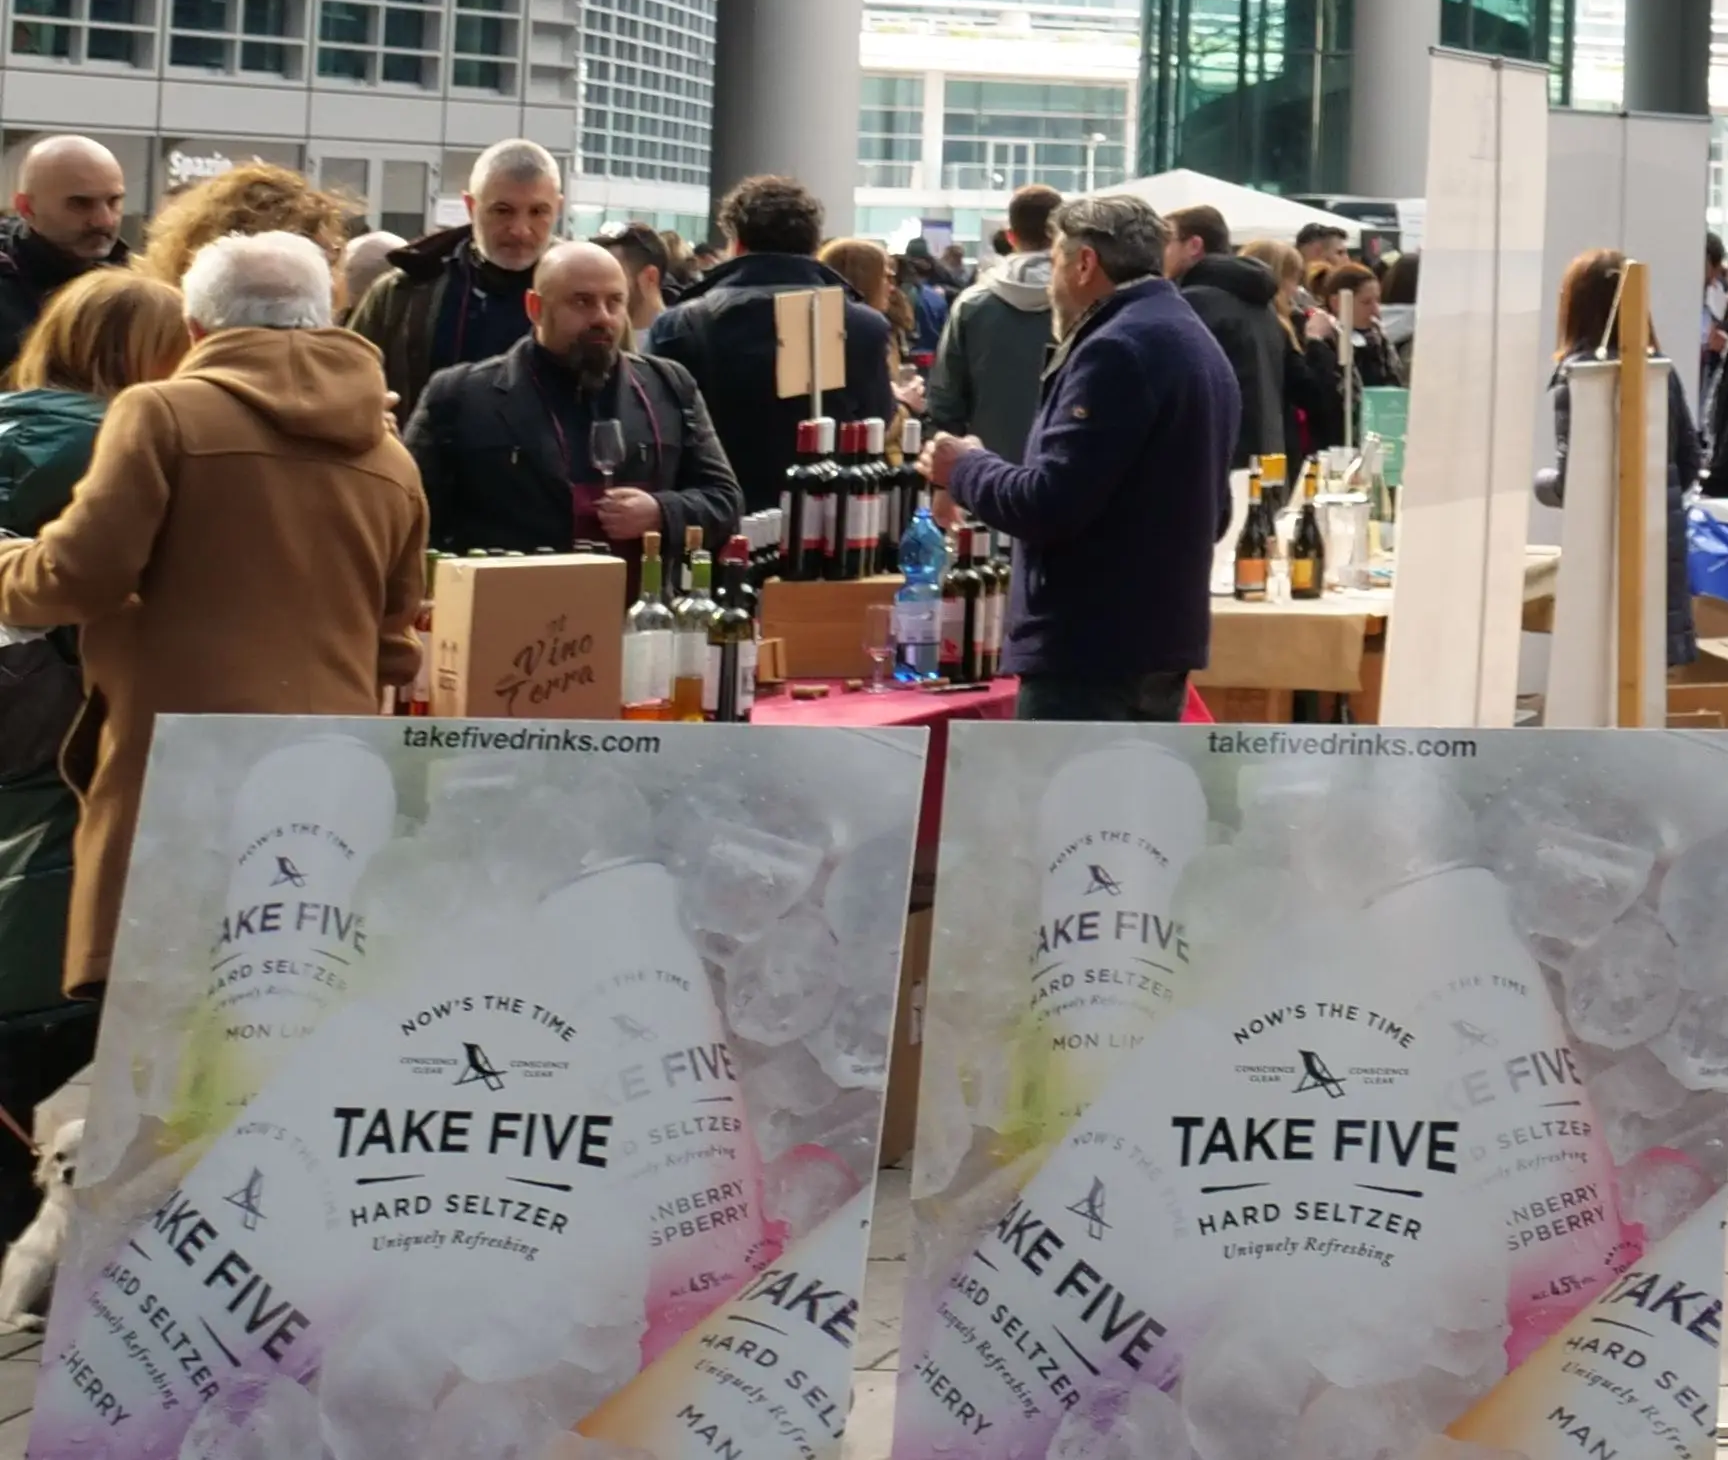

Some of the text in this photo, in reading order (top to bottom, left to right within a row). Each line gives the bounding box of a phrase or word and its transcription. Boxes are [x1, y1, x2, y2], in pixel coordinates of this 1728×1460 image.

[403, 726, 661, 755] takefivedrinks.com
[1208, 731, 1477, 759] takefivedrinks.com
[1085, 968, 1174, 1003] SELTZER
[401, 995, 577, 1042] NOW'S THE TIME
[1233, 1002, 1416, 1049] NOW'S THE TIME
[661, 1043, 736, 1088] FIVE
[1504, 1048, 1582, 1093] FIVE
[334, 1107, 613, 1168] TAKE FIVE
[1171, 1116, 1459, 1174] TAKE FIVE
[351, 1194, 569, 1234] HARD SELTZER
[1198, 1201, 1423, 1240] HARD SELTZER
[372, 1230, 539, 1261] Uniquely Refreshing
[1223, 1236, 1395, 1268] Uniquely Refreshing
[203, 1249, 311, 1364] FIVE
[736, 1270, 859, 1350] TAKE
[1054, 1259, 1168, 1372] FIVE
[1598, 1272, 1723, 1350] TAKE
[139, 1294, 220, 1404] SELTZER
[701, 1333, 779, 1368] HARD
[990, 1304, 1081, 1411] SELTZER
[694, 1358, 769, 1405] Uniquely
[976, 1339, 1041, 1420] Refreshing
[1562, 1361, 1639, 1405] Uniquely
[1566, 1336, 1717, 1438] HARD SEL
